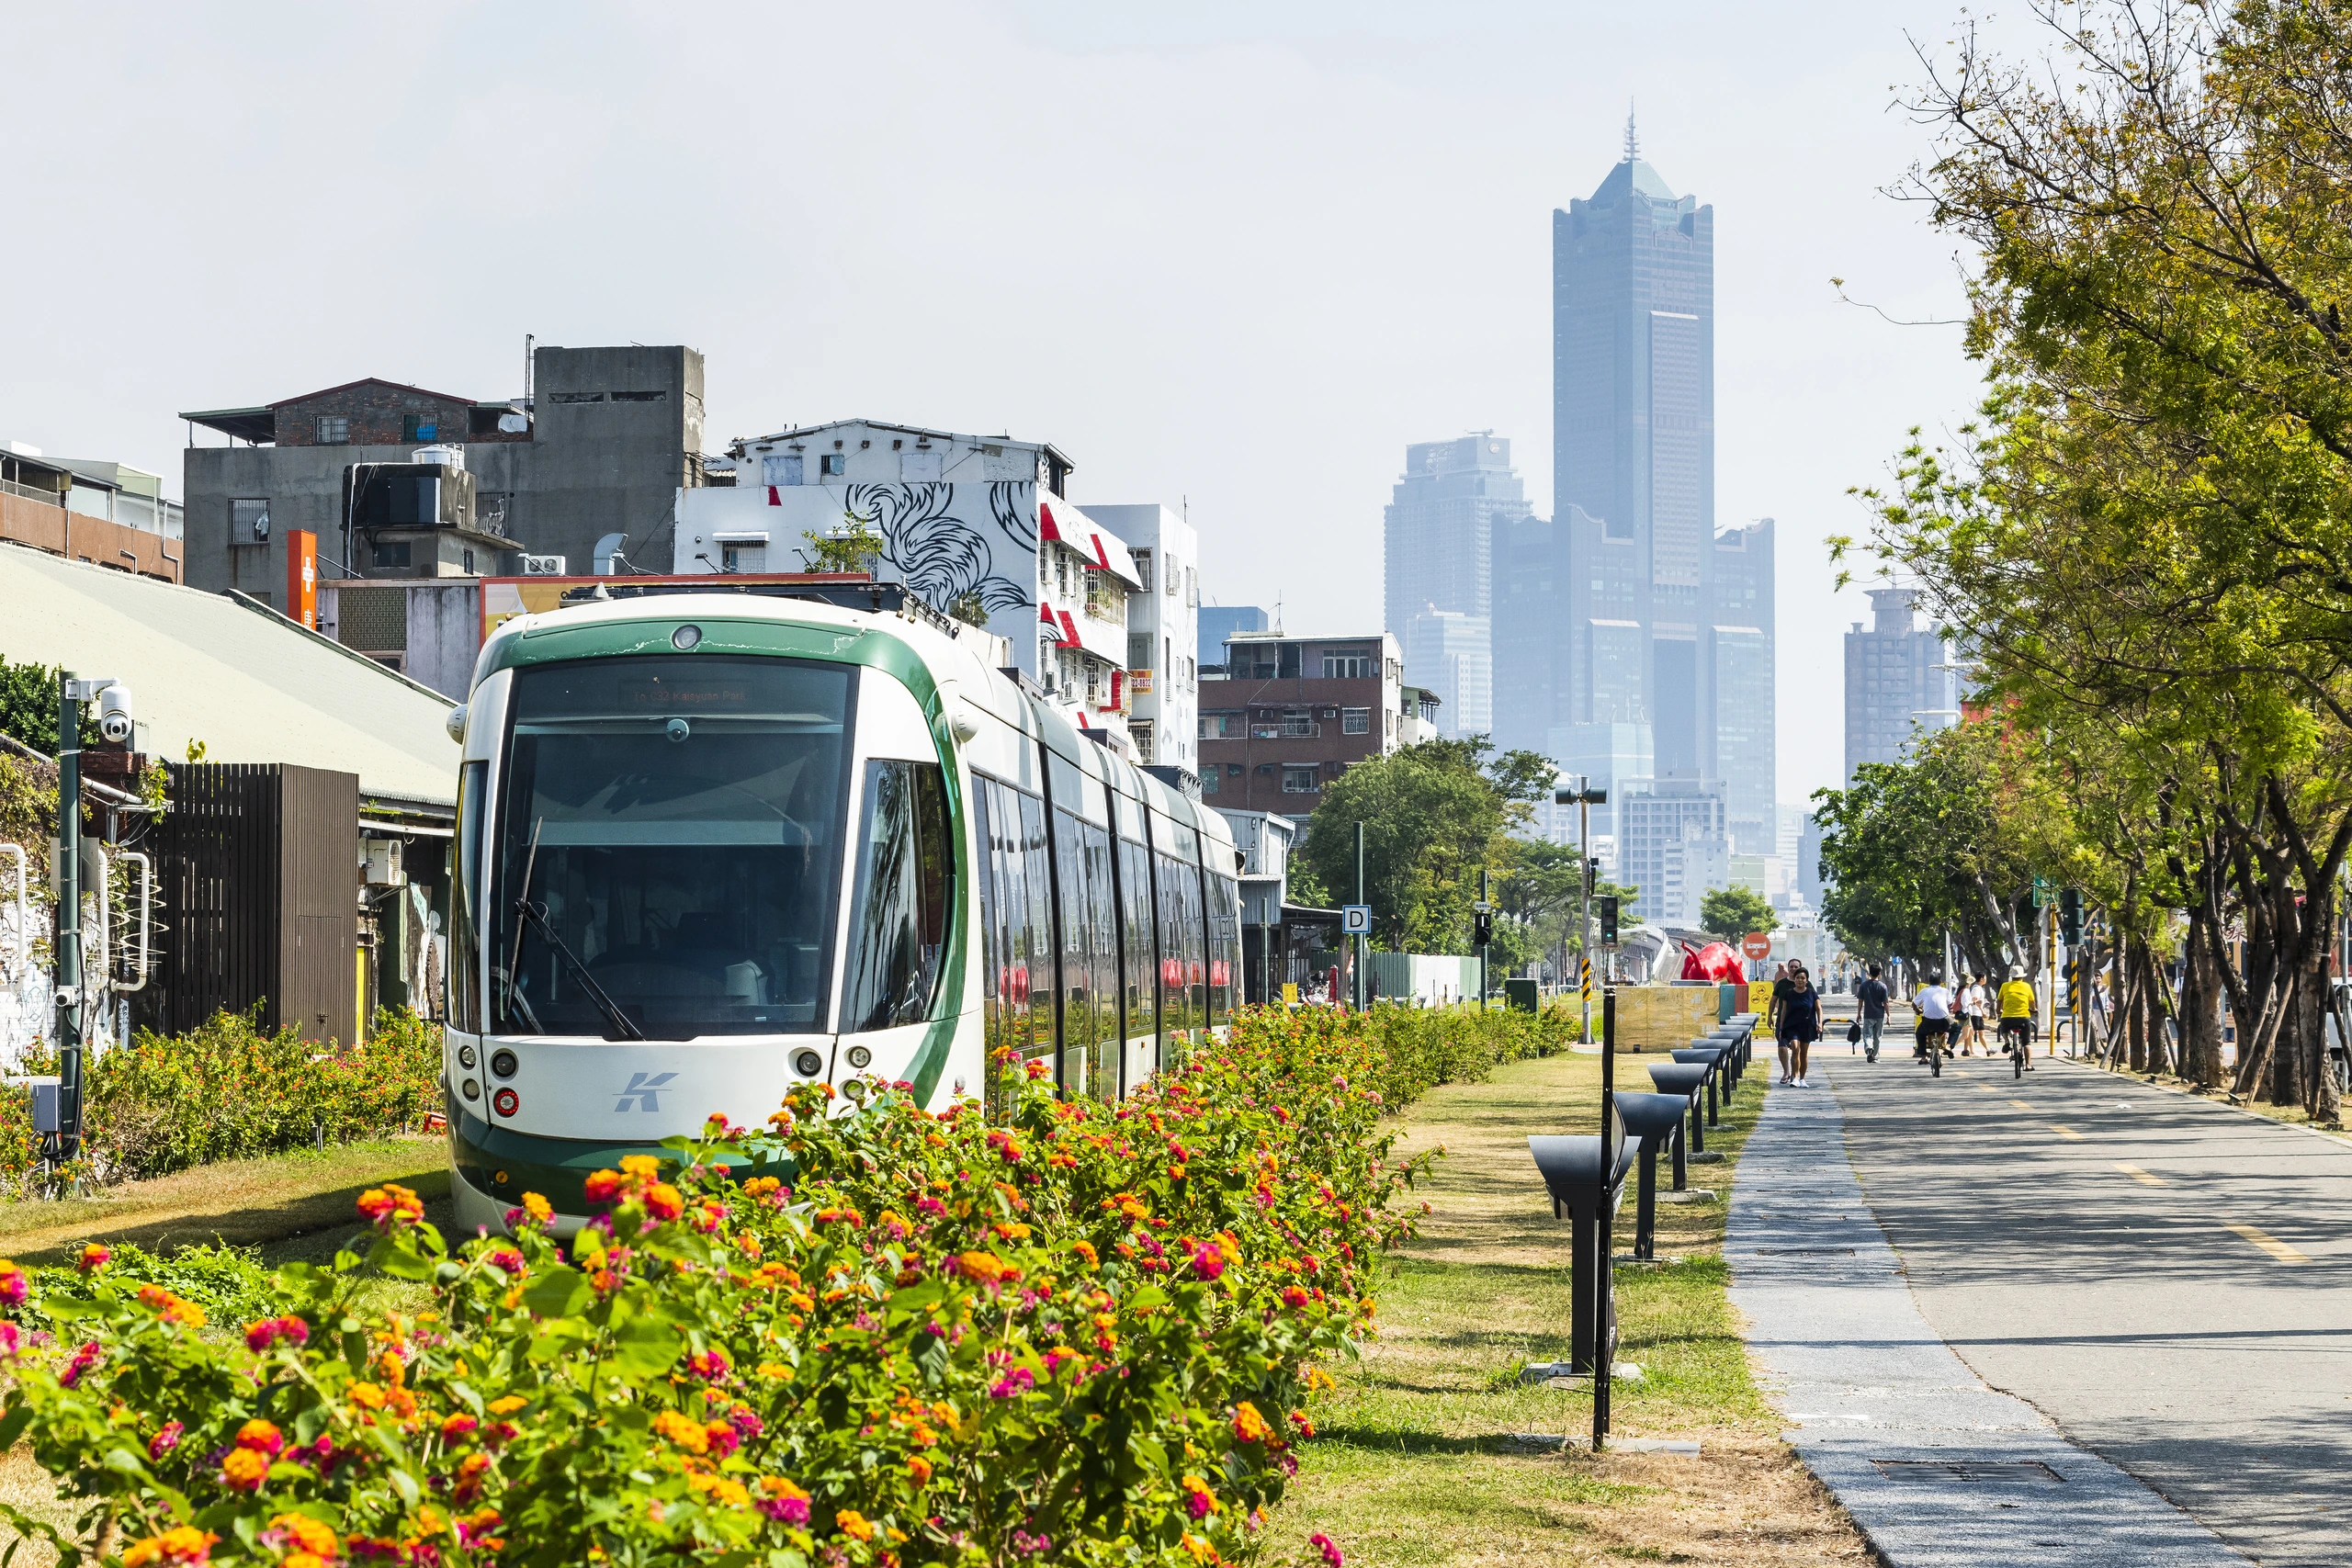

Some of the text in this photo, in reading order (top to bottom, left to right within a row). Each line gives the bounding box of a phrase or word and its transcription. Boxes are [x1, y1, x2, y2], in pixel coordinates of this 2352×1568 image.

[673, 691, 718, 704] Kaisyuan
[722, 690, 746, 701] Park
[1350, 910, 1363, 928] D
[612, 1072, 681, 1112] K
